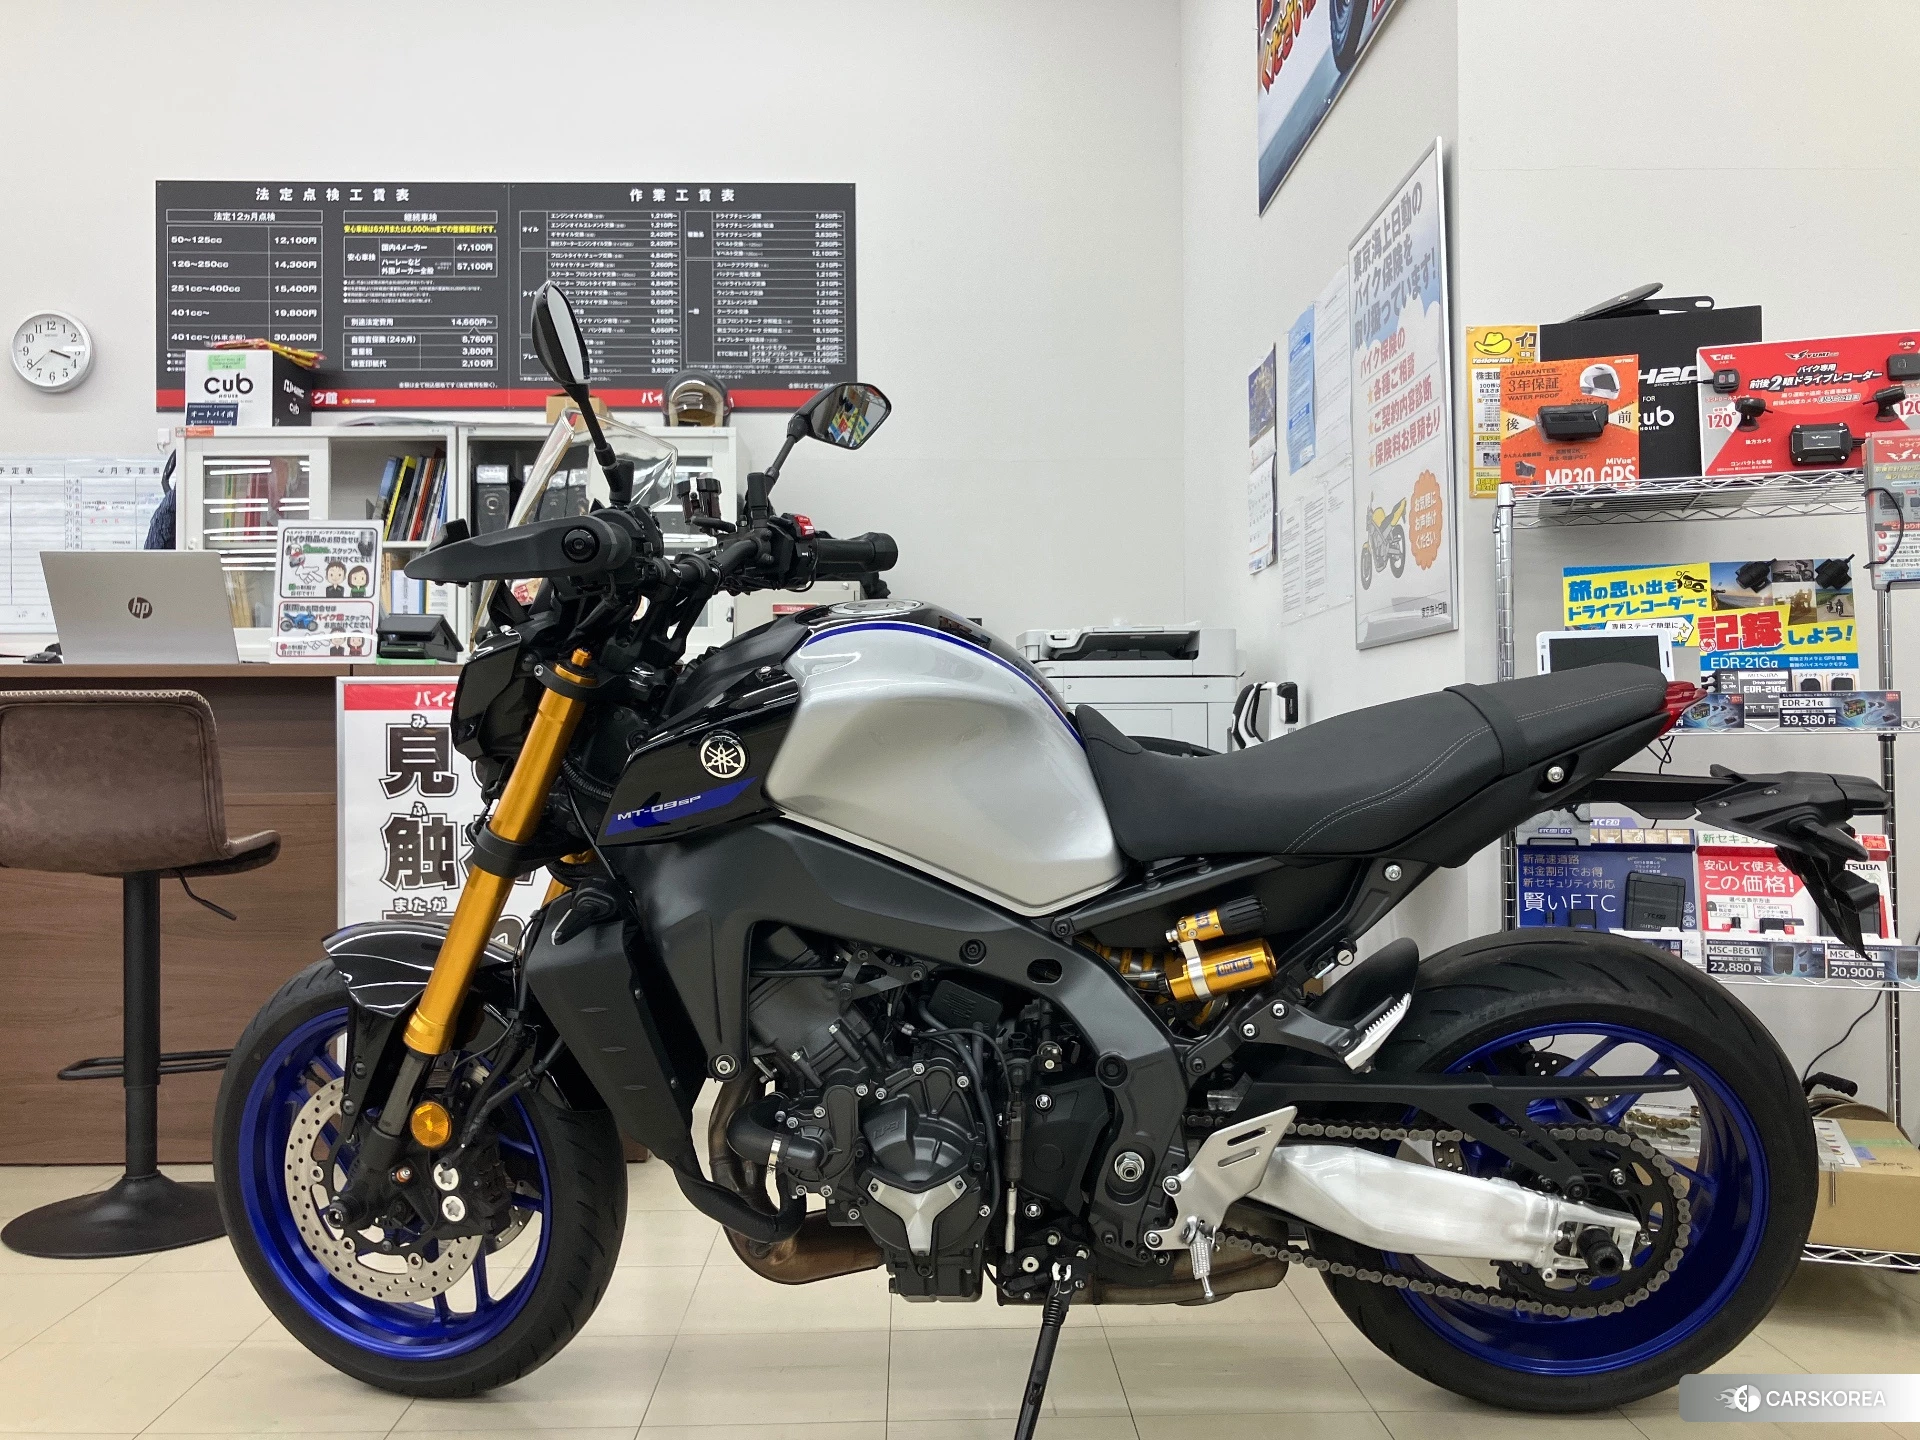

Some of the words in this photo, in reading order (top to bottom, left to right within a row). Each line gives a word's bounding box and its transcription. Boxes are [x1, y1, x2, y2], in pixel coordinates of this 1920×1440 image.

[256, 187, 410, 202] 法定点検工賃表
[630, 188, 734, 202] 作業工賃表
[404, 213, 437, 222] 継続車検
[1354, 182, 1423, 283] 東京海上日動の
[275, 261, 317, 269] 14,300円
[381, 267, 434, 275] 外国メーカー全般
[1354, 233, 1412, 314] バイク保険を
[35, 325, 42, 333] 11
[47, 321, 56, 330] 12
[63, 324, 66, 333] 1
[25, 334, 34, 343] 10
[71, 333, 77, 342] 2
[23, 346, 29, 356] 9
[1360, 327, 1405, 379] バイク保険の
[71, 359, 76, 368] 4
[462, 360, 493, 368] 2,100円
[1797, 364, 1837, 373] バイク専用
[37, 368, 42, 377] 7
[49, 372, 55, 381] 6
[63, 368, 68, 377] 5
[1373, 352, 1415, 402] 各種ご相談
[1510, 368, 1556, 376] GUARANTEE
[1509, 377, 1559, 392] 3年保証
[1374, 374, 1432, 433] ご契約内容診断
[1618, 410, 1631, 424] 前
[1638, 406, 1674, 426] ub
[1506, 418, 1520, 431] 後
[1375, 406, 1440, 467] 保険料お見積もり
[1568, 580, 1677, 602] 旅の思い出を
[132, 597, 149, 619] hp
[1568, 595, 1707, 621] ドライブレコーダーで
[1697, 611, 1783, 651] 記録
[1788, 625, 1853, 646] しよう!
[410, 714, 428, 728] み
[1783, 715, 1825, 725] 39,380
[379, 723, 459, 799] 見
[411, 801, 428, 817] ふ
[380, 812, 460, 891] 触
[1523, 854, 1579, 865] 新高速道路
[1523, 867, 1603, 877] 料金割引でお得
[1523, 878, 1615, 889] 新セキュリティ対応
[1704, 875, 1795, 893] この価格!
[1710, 961, 1751, 972] 22,880
[1754, 965, 1761, 973] 円
[1831, 967, 1874, 978] 20,900
[1877, 970, 1884, 978] 円
